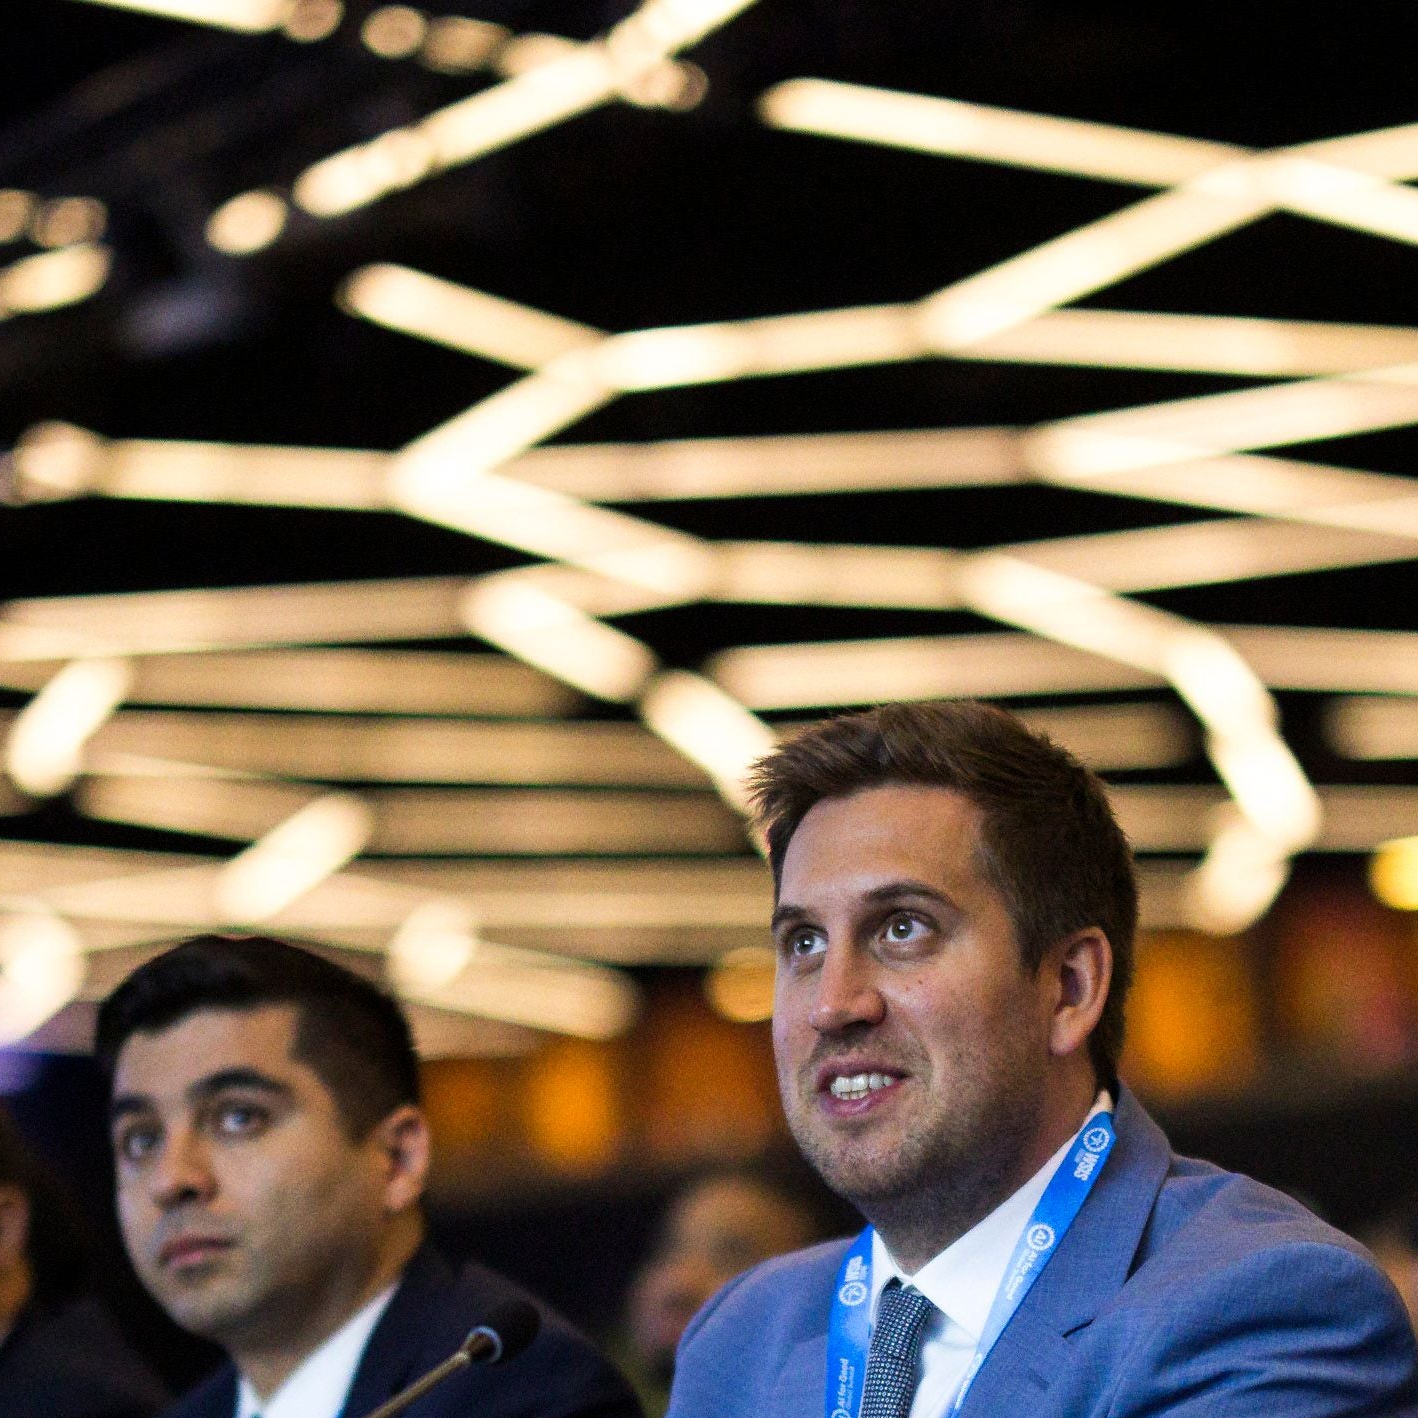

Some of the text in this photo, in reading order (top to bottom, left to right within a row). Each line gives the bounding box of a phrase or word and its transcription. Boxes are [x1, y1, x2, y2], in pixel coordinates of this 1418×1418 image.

[1074, 1152, 1100, 1181] WSIS
[838, 1358, 848, 1382] Good
[837, 1383, 846, 1396] for
